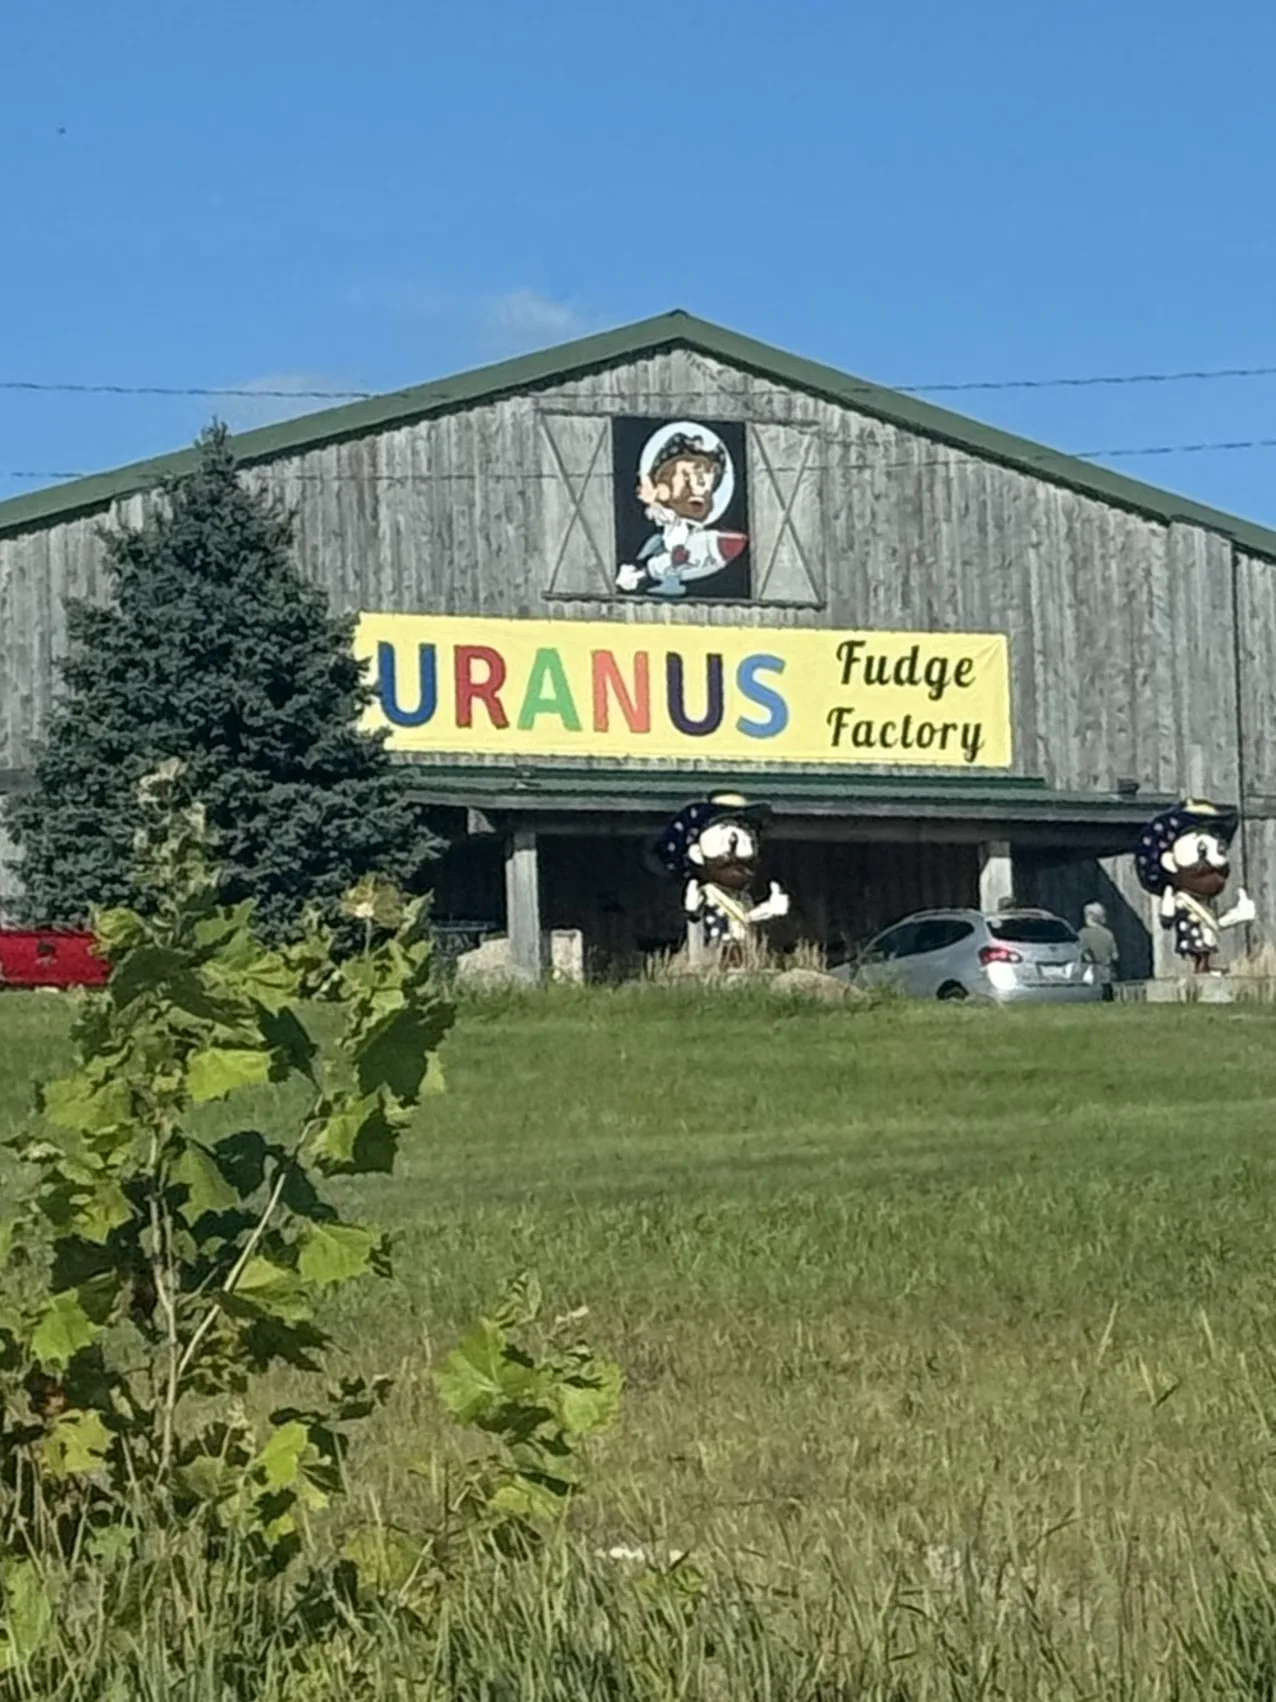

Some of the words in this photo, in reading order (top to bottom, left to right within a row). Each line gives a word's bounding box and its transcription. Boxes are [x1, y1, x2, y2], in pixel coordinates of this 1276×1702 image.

[378, 641, 788, 739] URANUS
[836, 639, 975, 701] Fudge
[827, 707, 985, 762] Factory
